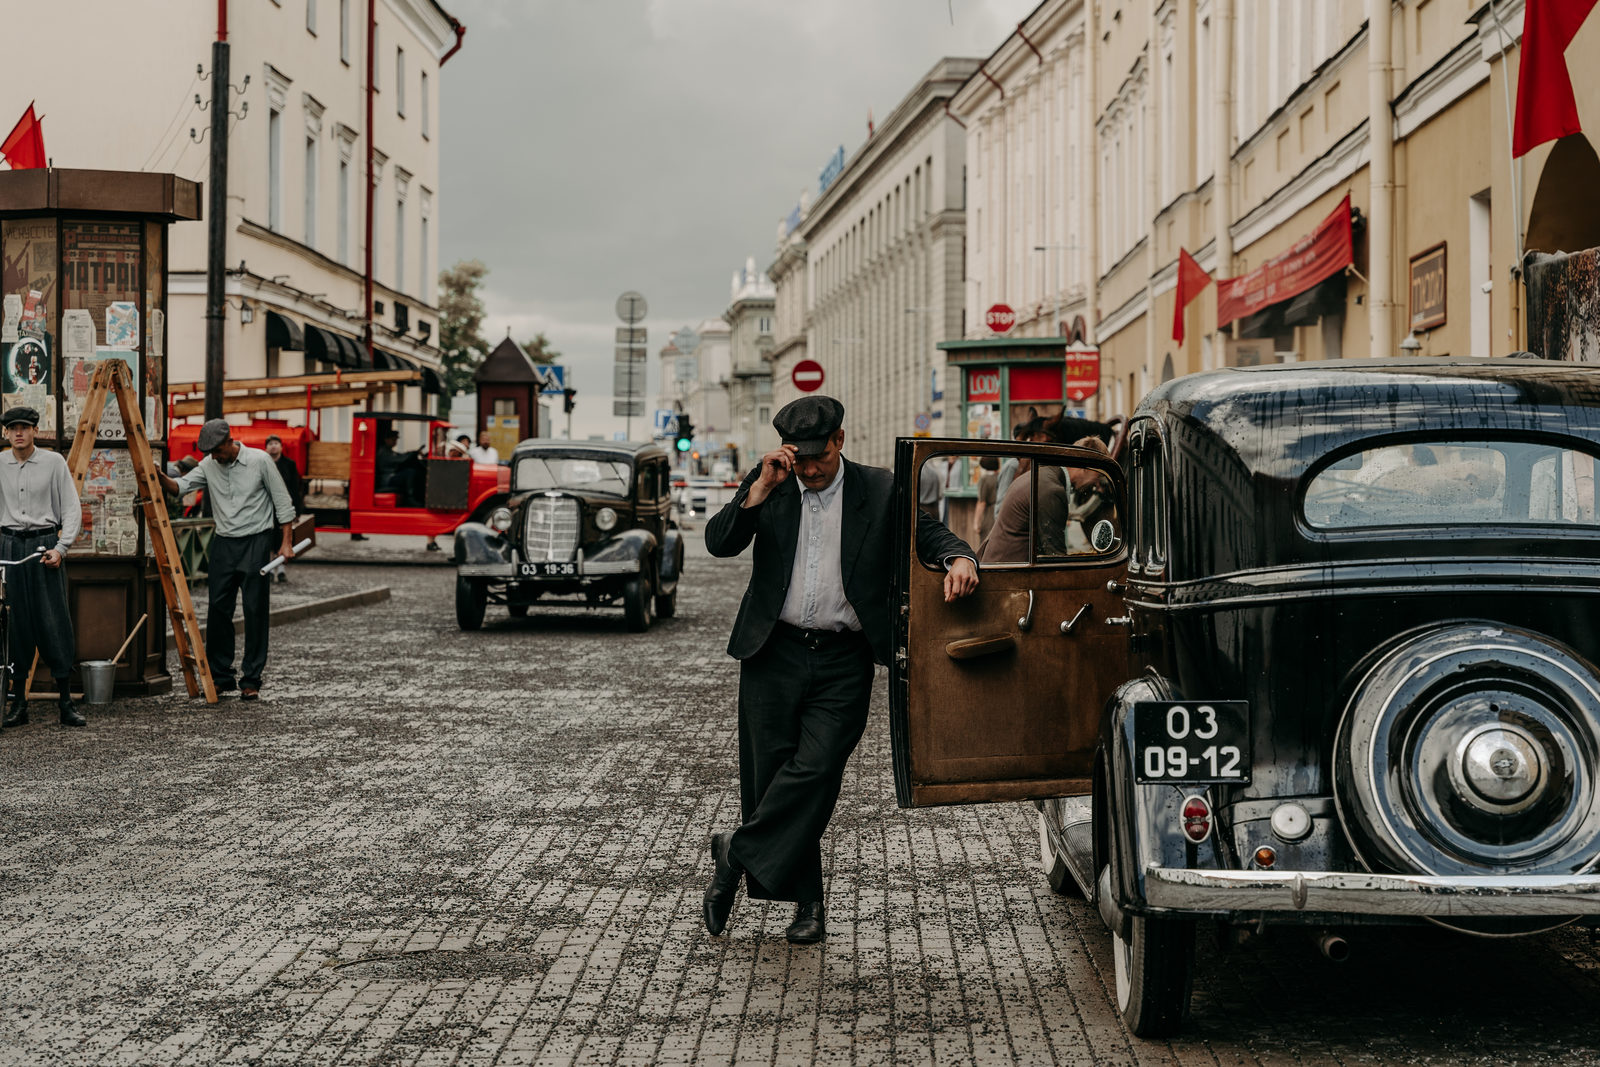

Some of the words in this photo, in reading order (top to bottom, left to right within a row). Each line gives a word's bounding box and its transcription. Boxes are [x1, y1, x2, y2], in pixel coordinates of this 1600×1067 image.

[987, 312, 1016, 325] STOP
[970, 375, 1001, 395] LODY
[544, 564, 574, 574] 19-36
[1144, 746, 1241, 778] 09-12
